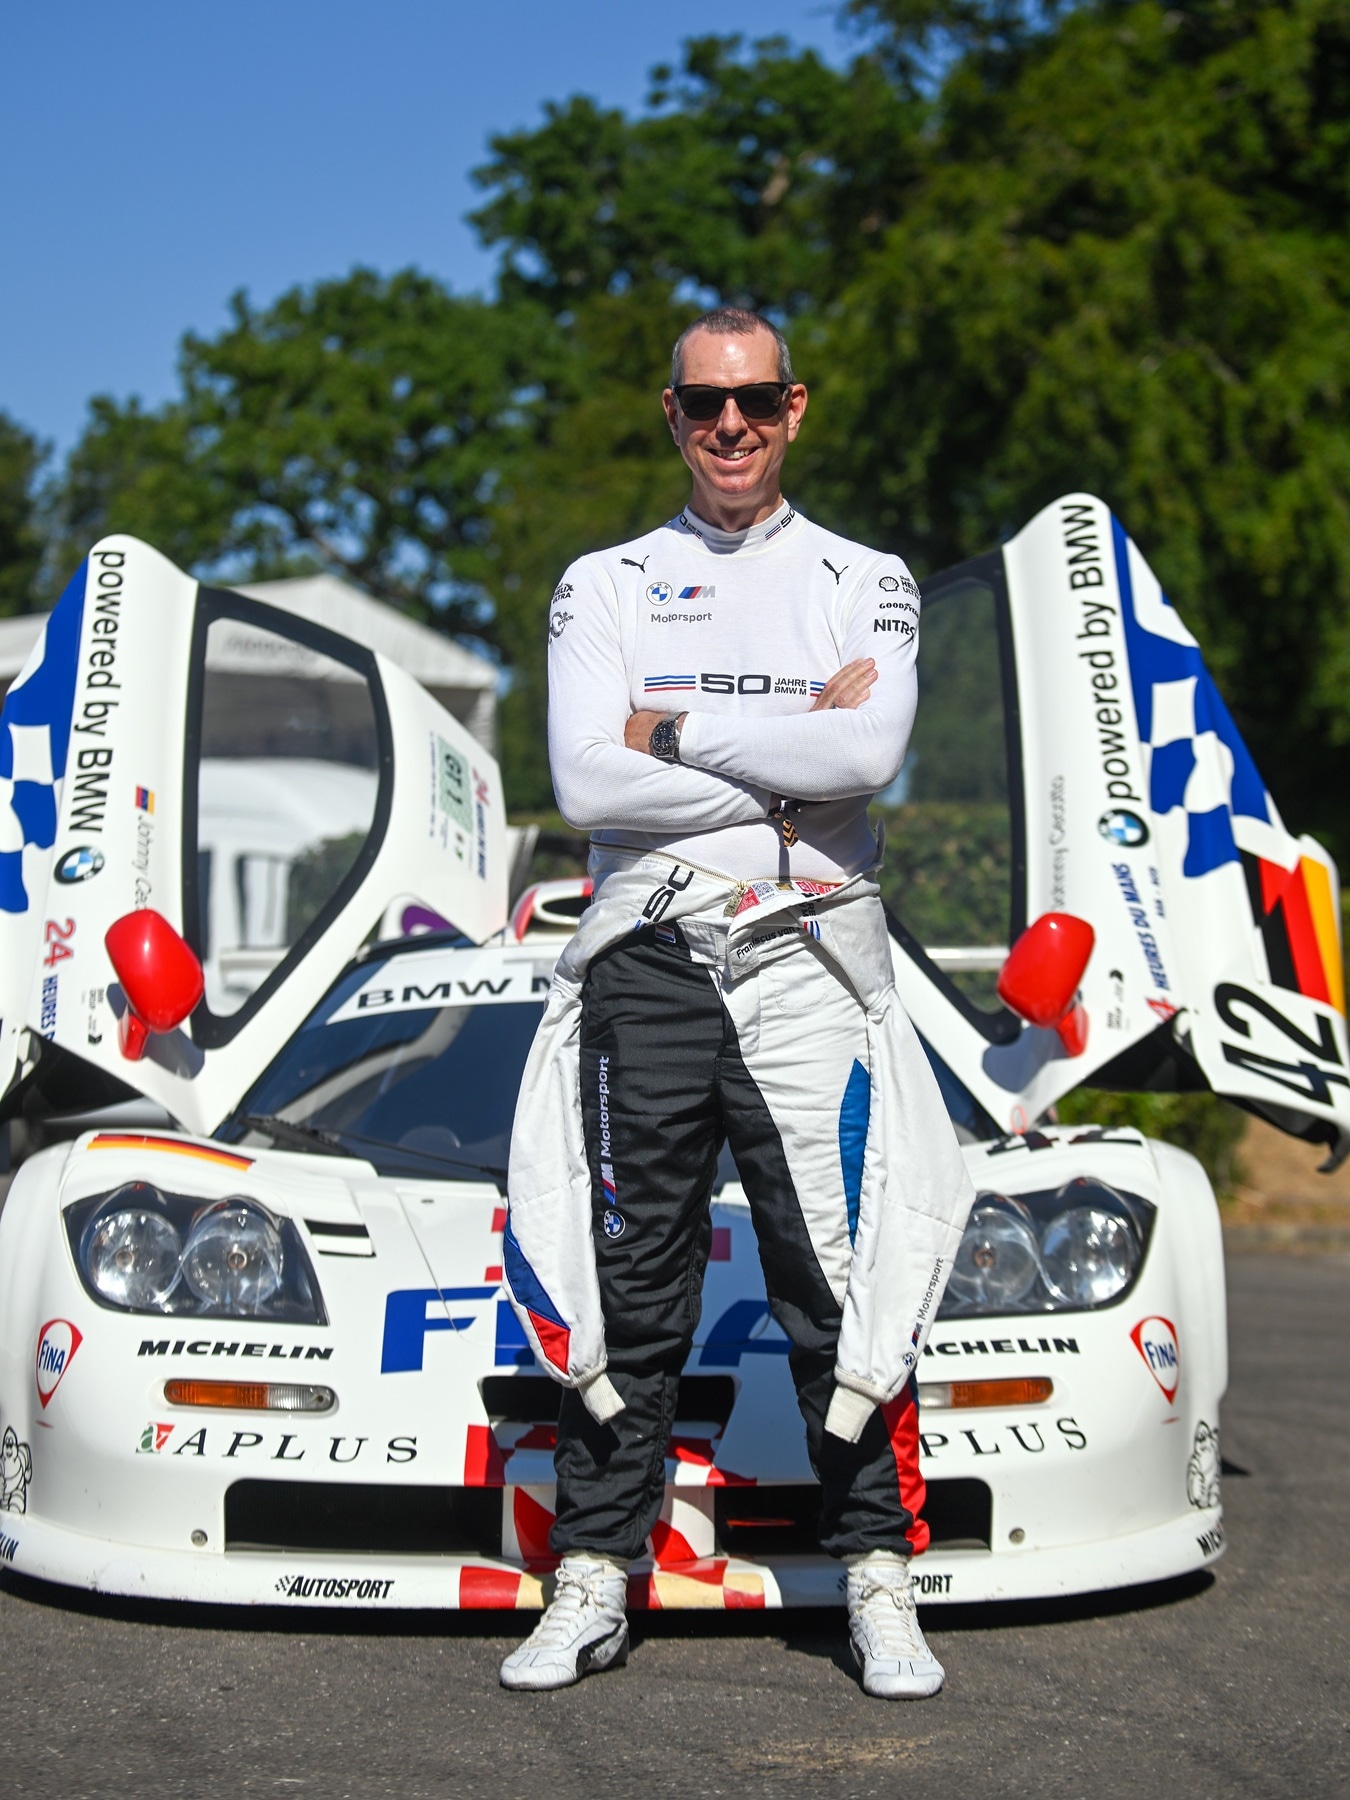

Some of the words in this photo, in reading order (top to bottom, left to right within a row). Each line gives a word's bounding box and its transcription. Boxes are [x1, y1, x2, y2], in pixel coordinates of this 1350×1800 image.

[1061, 504, 1104, 590] BMW
[86, 550, 125, 689] powered
[651, 612, 713, 623] Motorsport
[1076, 600, 1117, 640] by
[700, 673, 772, 695] 50
[774, 678, 807, 688] JAHRE
[774, 686, 797, 694] BMW
[799, 688, 807, 696] M
[74, 701, 119, 736] by
[1078, 650, 1142, 802] powered
[69, 749, 113, 832] BMW
[1111, 862, 1144, 905] MANS
[1129, 906, 1152, 930] DU
[44, 917, 76, 968] 24
[1136, 931, 1171, 992] HEURES
[42, 974, 58, 1029] HEURES
[358, 978, 513, 1009] BMW
[1212, 981, 1350, 1109] 42
[598, 1055, 611, 1158] Motorsport
[917, 1258, 944, 1320] Motorsport
[38, 1339, 66, 1375] FINA
[137, 1340, 334, 1360] MICHELIN
[922, 1337, 1080, 1356] ICHELIN
[1144, 1340, 1179, 1369] FINA
[172, 1428, 418, 1463] APLUS
[919, 1416, 1087, 1459] PLUS
[287, 1575, 395, 1599] AUTOSPORT
